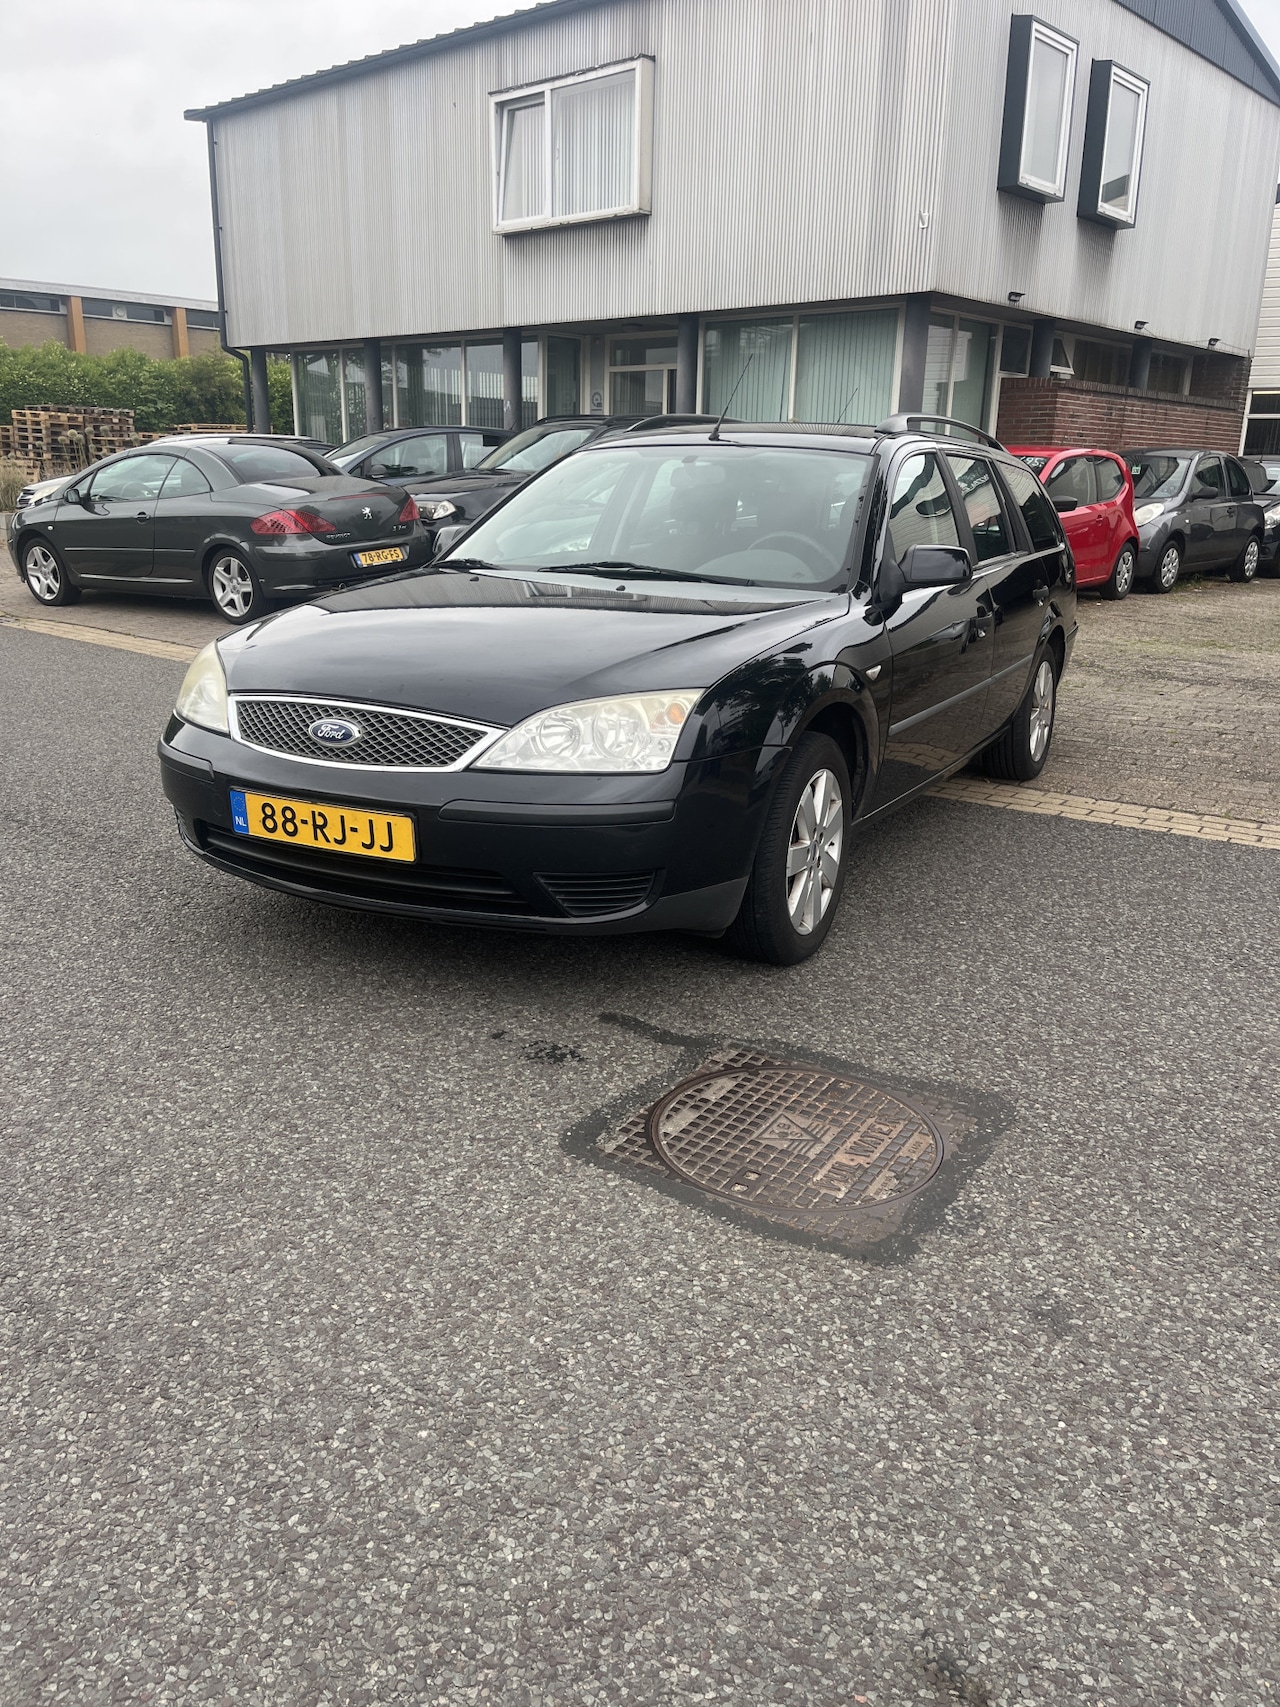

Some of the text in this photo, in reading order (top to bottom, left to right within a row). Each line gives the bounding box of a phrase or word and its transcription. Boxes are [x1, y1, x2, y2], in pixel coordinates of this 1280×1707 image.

[361, 549, 400, 563] 78-RG-FS
[318, 724, 344, 740] Ford
[234, 815, 247, 827] NL
[261, 802, 394, 853] 88-RJ-JJ
[845, 1116, 900, 1158] WATER
